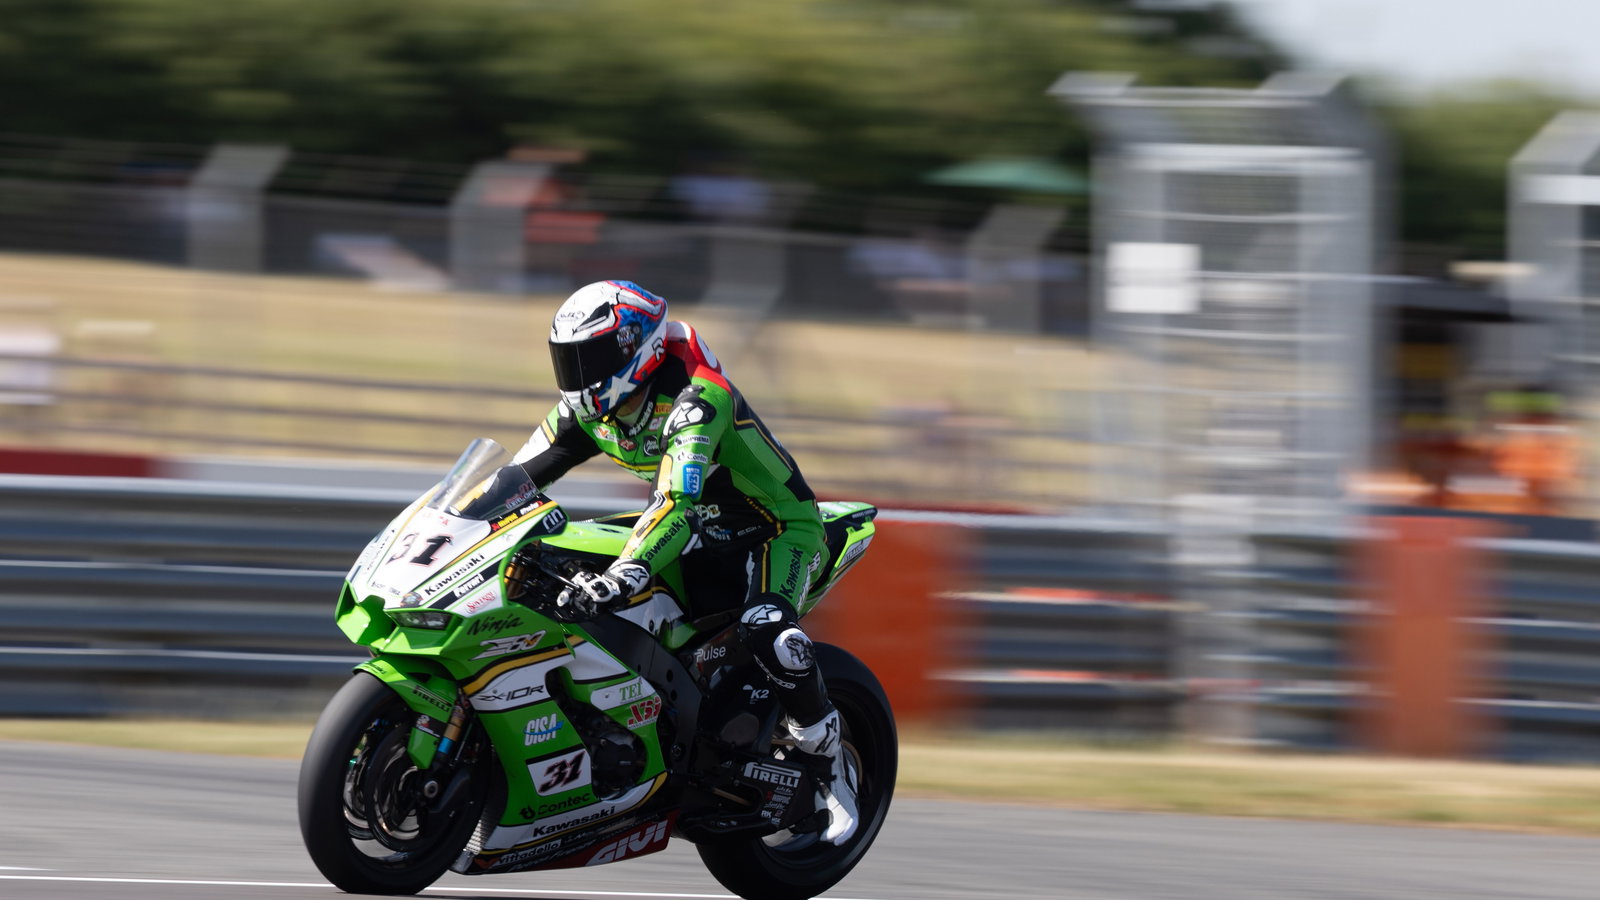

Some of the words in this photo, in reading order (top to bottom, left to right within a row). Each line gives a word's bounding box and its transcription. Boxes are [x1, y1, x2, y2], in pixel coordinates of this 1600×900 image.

[640, 515, 686, 561] awasaki
[424, 553, 485, 596] Kawasaki
[466, 614, 523, 636] Ninja
[750, 689, 770, 700] K2
[537, 751, 586, 793] 31
[743, 761, 801, 789] PIRELLI
[536, 793, 590, 816] Contec
[532, 806, 615, 837] Kawasaki
[585, 818, 668, 866] GIVI
